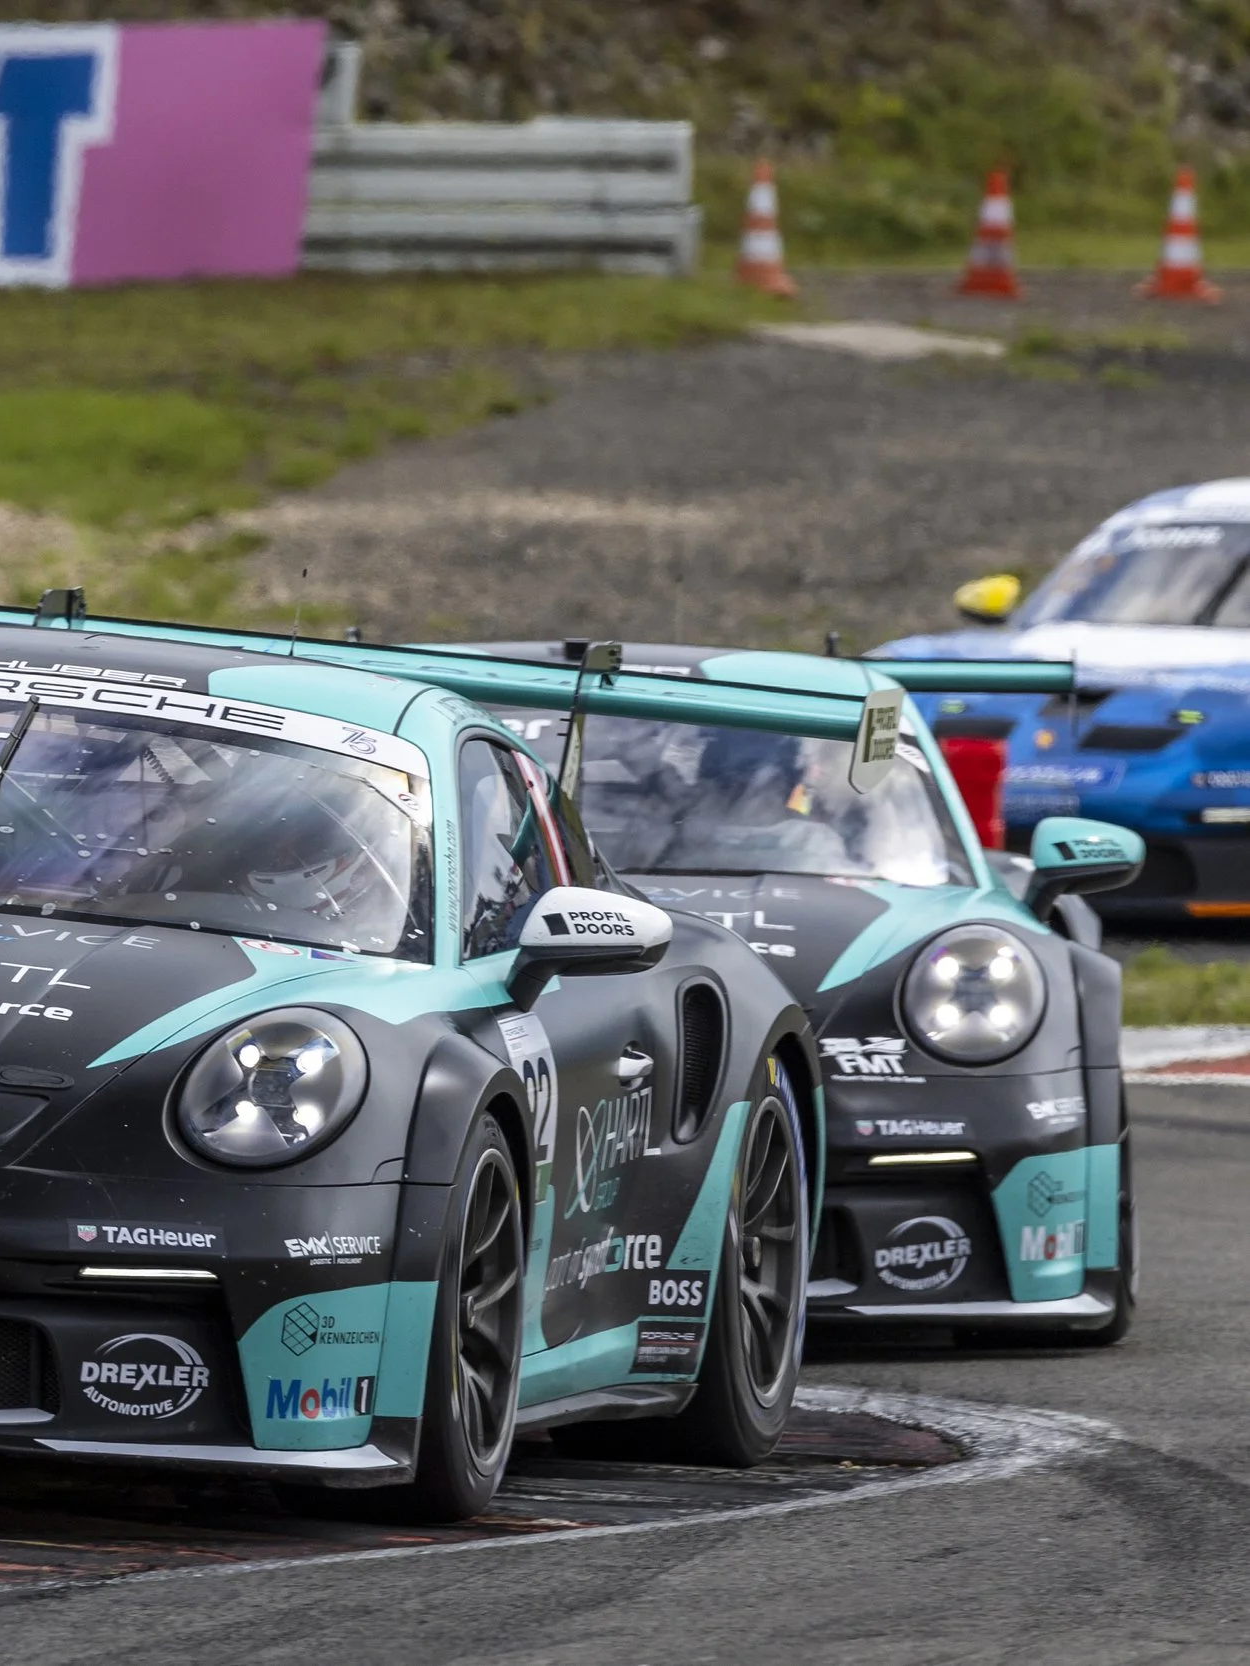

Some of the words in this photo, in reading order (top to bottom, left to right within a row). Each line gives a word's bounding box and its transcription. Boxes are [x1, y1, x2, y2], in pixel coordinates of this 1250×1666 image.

[569, 911, 631, 923] PROFIL
[574, 923, 635, 937] DOORS
[835, 1054, 905, 1074] FMT
[600, 1086, 661, 1171] HARTL
[333, 1236, 382, 1255] SERVICE
[874, 1238, 971, 1269] DREXLER
[648, 1280, 703, 1306] BOSS
[321, 1316, 335, 1328] 3D
[319, 1331, 380, 1345] KENNZEICHEN
[80, 1361, 210, 1391] DREXLER
[83, 1386, 173, 1416] AUTOMOTIVE
[266, 1377, 352, 1420] Mobil
